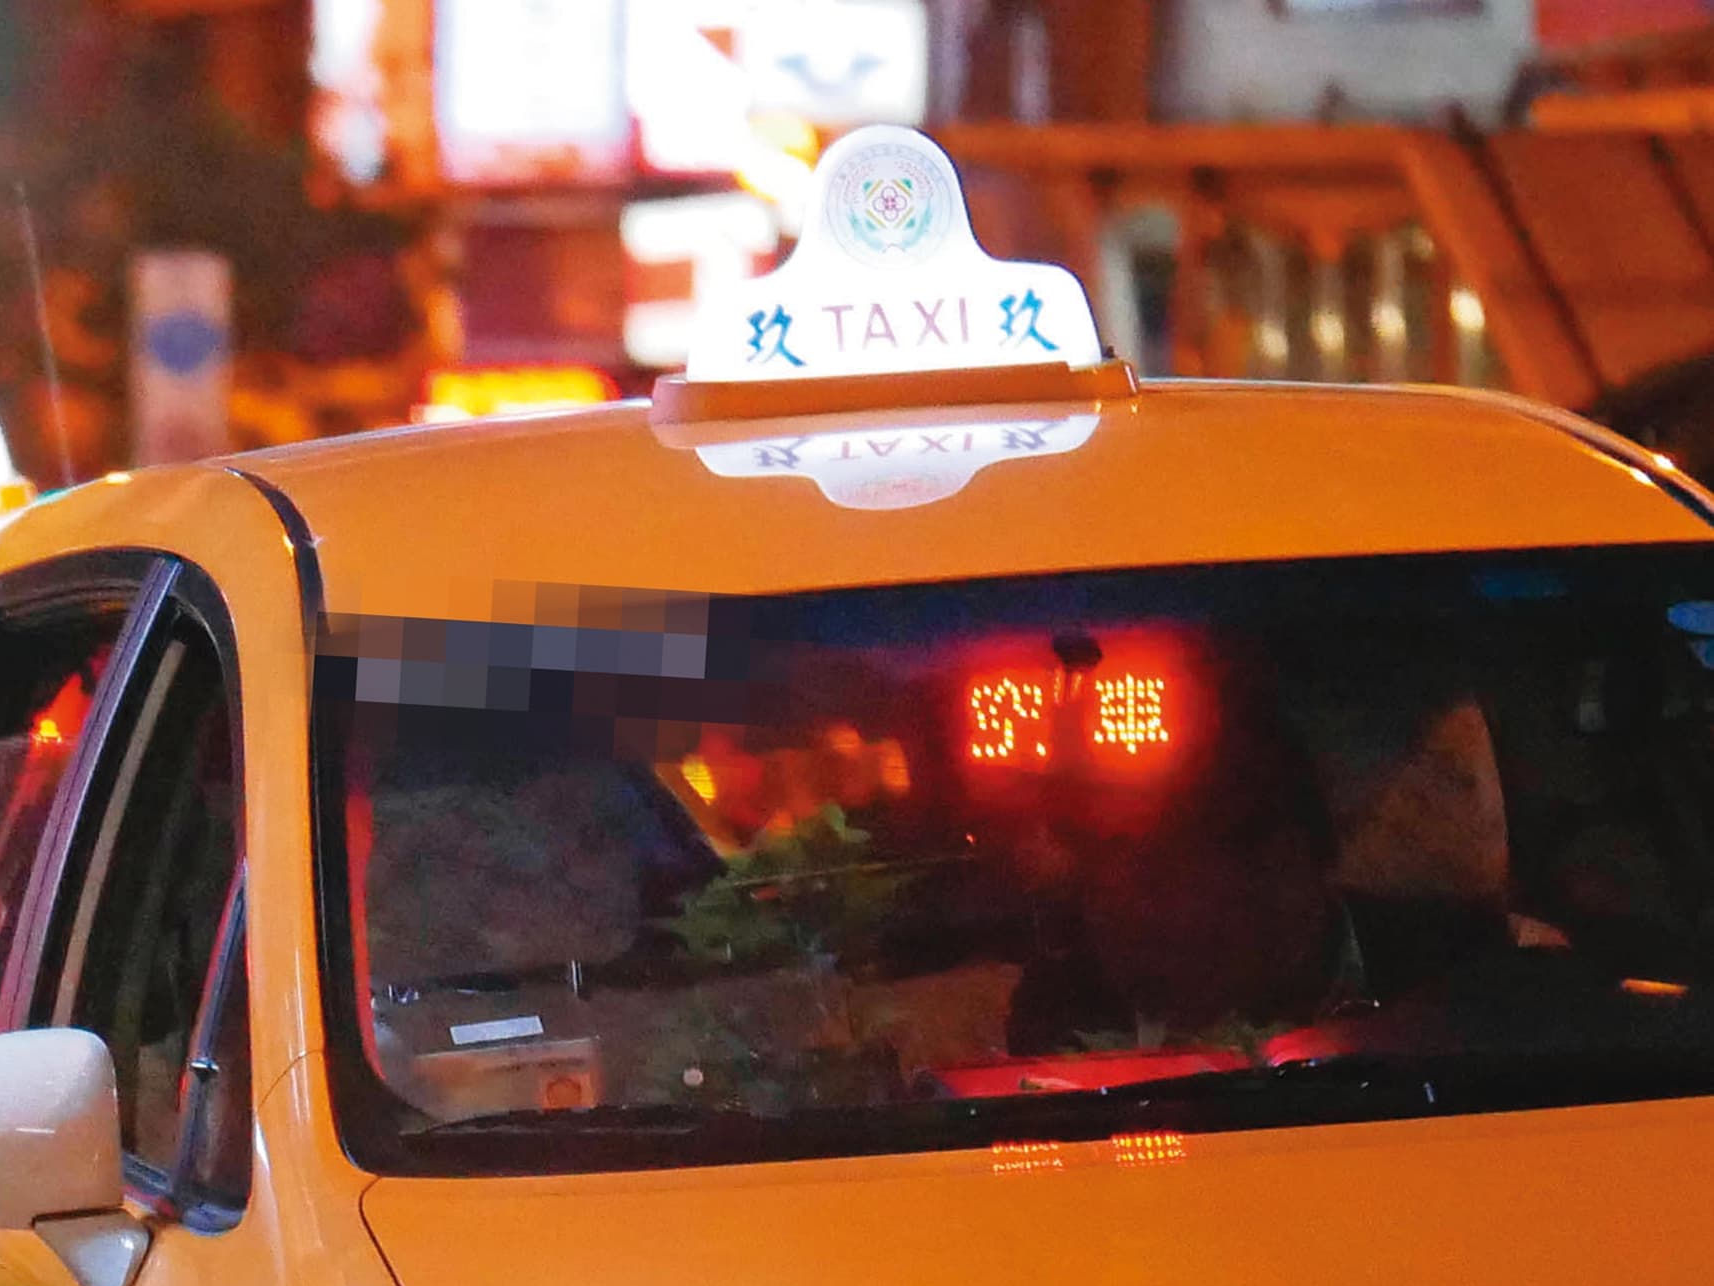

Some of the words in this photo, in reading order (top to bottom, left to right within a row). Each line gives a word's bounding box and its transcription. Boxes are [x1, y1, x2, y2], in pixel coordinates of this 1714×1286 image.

[746, 304, 807, 367] 玖
[822, 297, 971, 351] TAXI
[999, 288, 1060, 351] 玖
